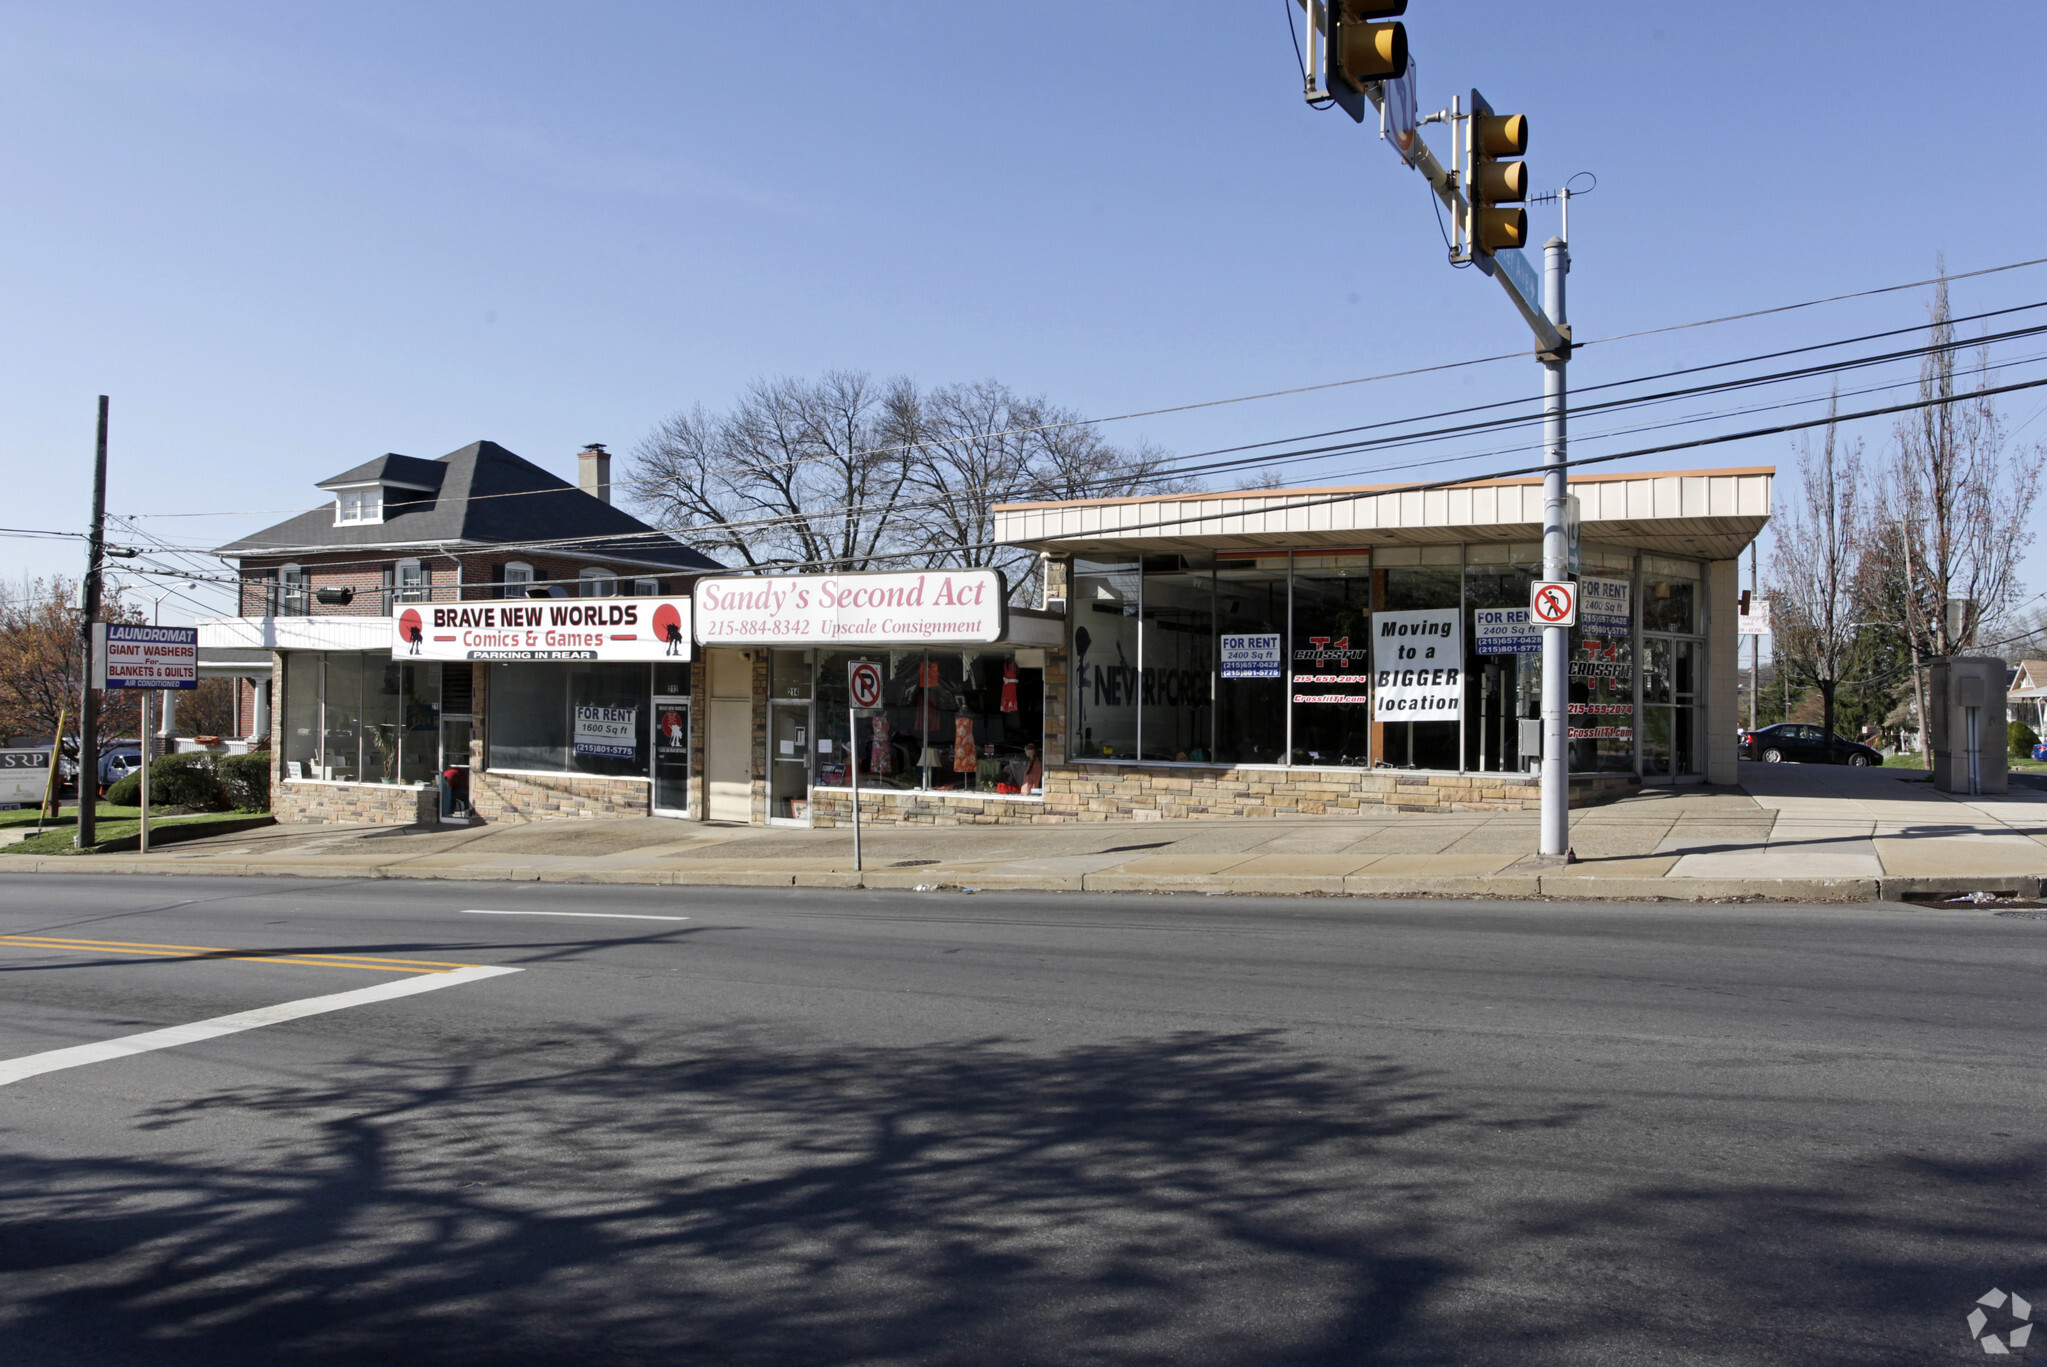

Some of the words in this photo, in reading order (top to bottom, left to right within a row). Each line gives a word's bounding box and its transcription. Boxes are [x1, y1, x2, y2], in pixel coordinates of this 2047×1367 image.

[1582, 580, 1600, 596] FOR
[1602, 583, 1628, 598] RENT
[702, 580, 810, 618] Sandy's
[818, 575, 926, 609] Second
[933, 576, 986, 606] Act
[1605, 602, 1615, 613] Sq
[1617, 603, 1623, 612] ft
[434, 608, 494, 627] BRAVE
[500, 607, 542, 627] NEW
[550, 605, 638, 626] WORLDS
[1478, 612, 1502, 624] FOR
[1507, 611, 1530, 622] REN
[707, 619, 810, 636] 215-884-8342
[820, 618, 877, 638] Upscale
[881, 618, 982, 637] Consignment
[1381, 620, 1452, 638] Moving
[1484, 626, 1508, 635] 2400
[1511, 626, 1525, 635] Sq
[110, 627, 194, 642] LAUNDROMAT
[463, 630, 519, 647] Comics
[526, 630, 538, 647] &
[545, 630, 604, 647] Games
[1223, 638, 1245, 649] FOR
[1248, 638, 1277, 648] RENT
[1479, 637, 1542, 645] (215)657-0428
[109, 645, 140, 656] GIANT
[144, 646, 194, 657] WASHERS
[552, 651, 590, 659] REAR
[1294, 650, 1366, 660] CROSSFIT
[1398, 645, 1416, 660] to
[1425, 646, 1436, 659] a
[1479, 645, 1542, 654] (215)801-5775
[1251, 652, 1263, 660] Sq
[109, 666, 154, 676] BLANKETS
[157, 668, 162, 676] &
[165, 667, 194, 677] QUILTS
[1568, 661, 1632, 678] CROSSFIT
[1293, 675, 1366, 683] 215-659-2074
[1378, 668, 1459, 687] BIGGER
[1293, 694, 1366, 703] CrossfitT1.com
[1378, 695, 1459, 711] location
[578, 707, 599, 720] FOR
[603, 708, 632, 722] RENT
[1568, 704, 1633, 714] 215-659-2074
[583, 724, 603, 732] 1600
[606, 725, 618, 735] Sq
[620, 726, 627, 734] ft
[1568, 727, 1632, 738] CrossfitT1.com
[577, 743, 632, 755] (215)801-5775
[5, 754, 43, 767] SRP
